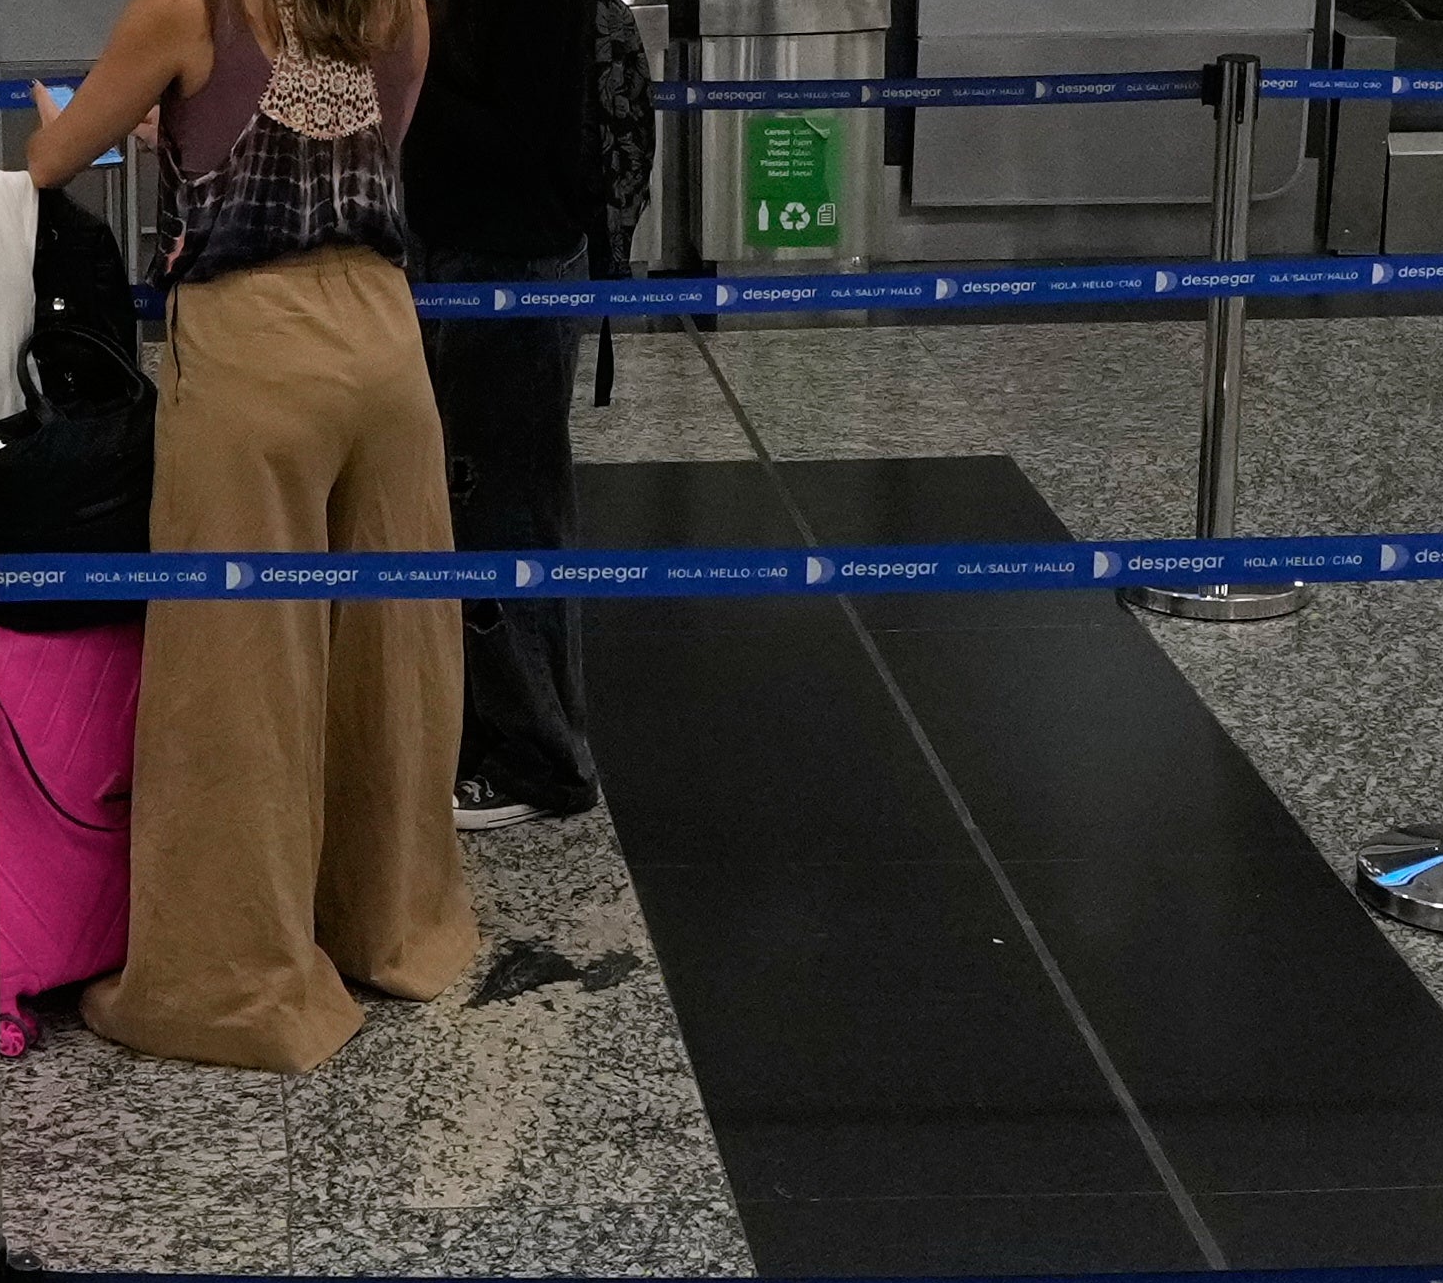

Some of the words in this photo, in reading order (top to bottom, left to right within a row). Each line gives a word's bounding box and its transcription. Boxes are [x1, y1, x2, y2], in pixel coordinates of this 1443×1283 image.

[708, 91, 765, 102] despegar
[883, 88, 941, 99] despegar
[521, 293, 595, 306] despegar
[743, 288, 816, 302] despegar
[963, 281, 1036, 295] despegar
[1182, 274, 1255, 288] despegar
[261, 567, 358, 585] despegar
[551, 565, 648, 583] despegar
[842, 561, 938, 579] despegar
[1129, 556, 1224, 573] despegar
